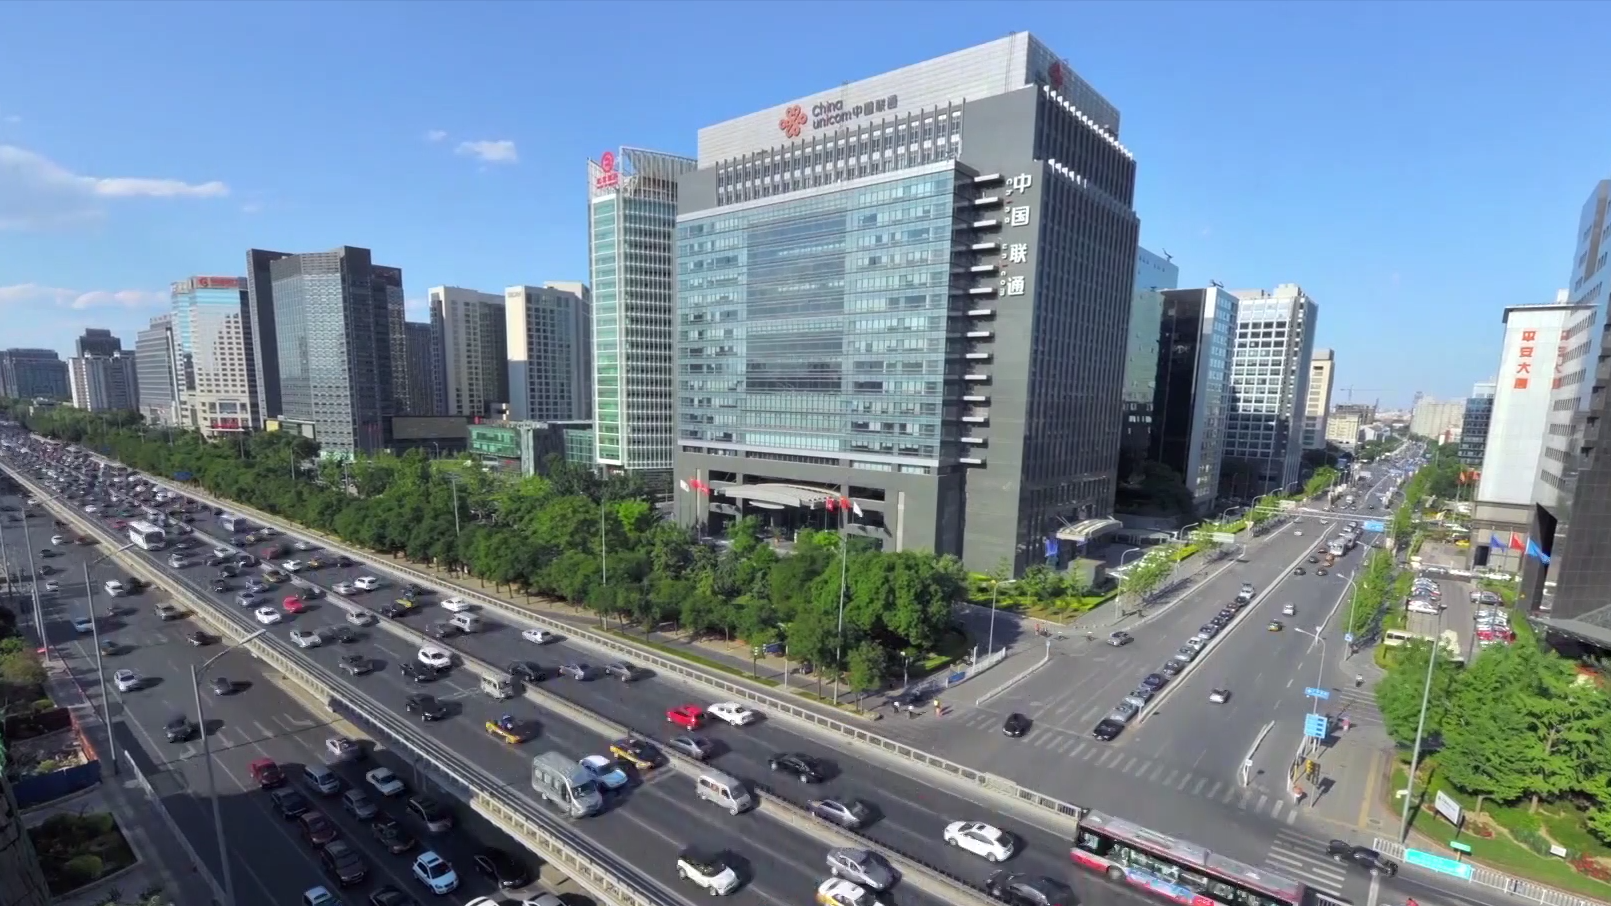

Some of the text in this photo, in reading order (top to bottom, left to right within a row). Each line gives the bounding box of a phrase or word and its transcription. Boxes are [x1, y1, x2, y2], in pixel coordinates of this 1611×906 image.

[812, 100, 843, 117] China
[812, 110, 852, 129] unicom
[1006, 172, 1033, 297] 中国联通
